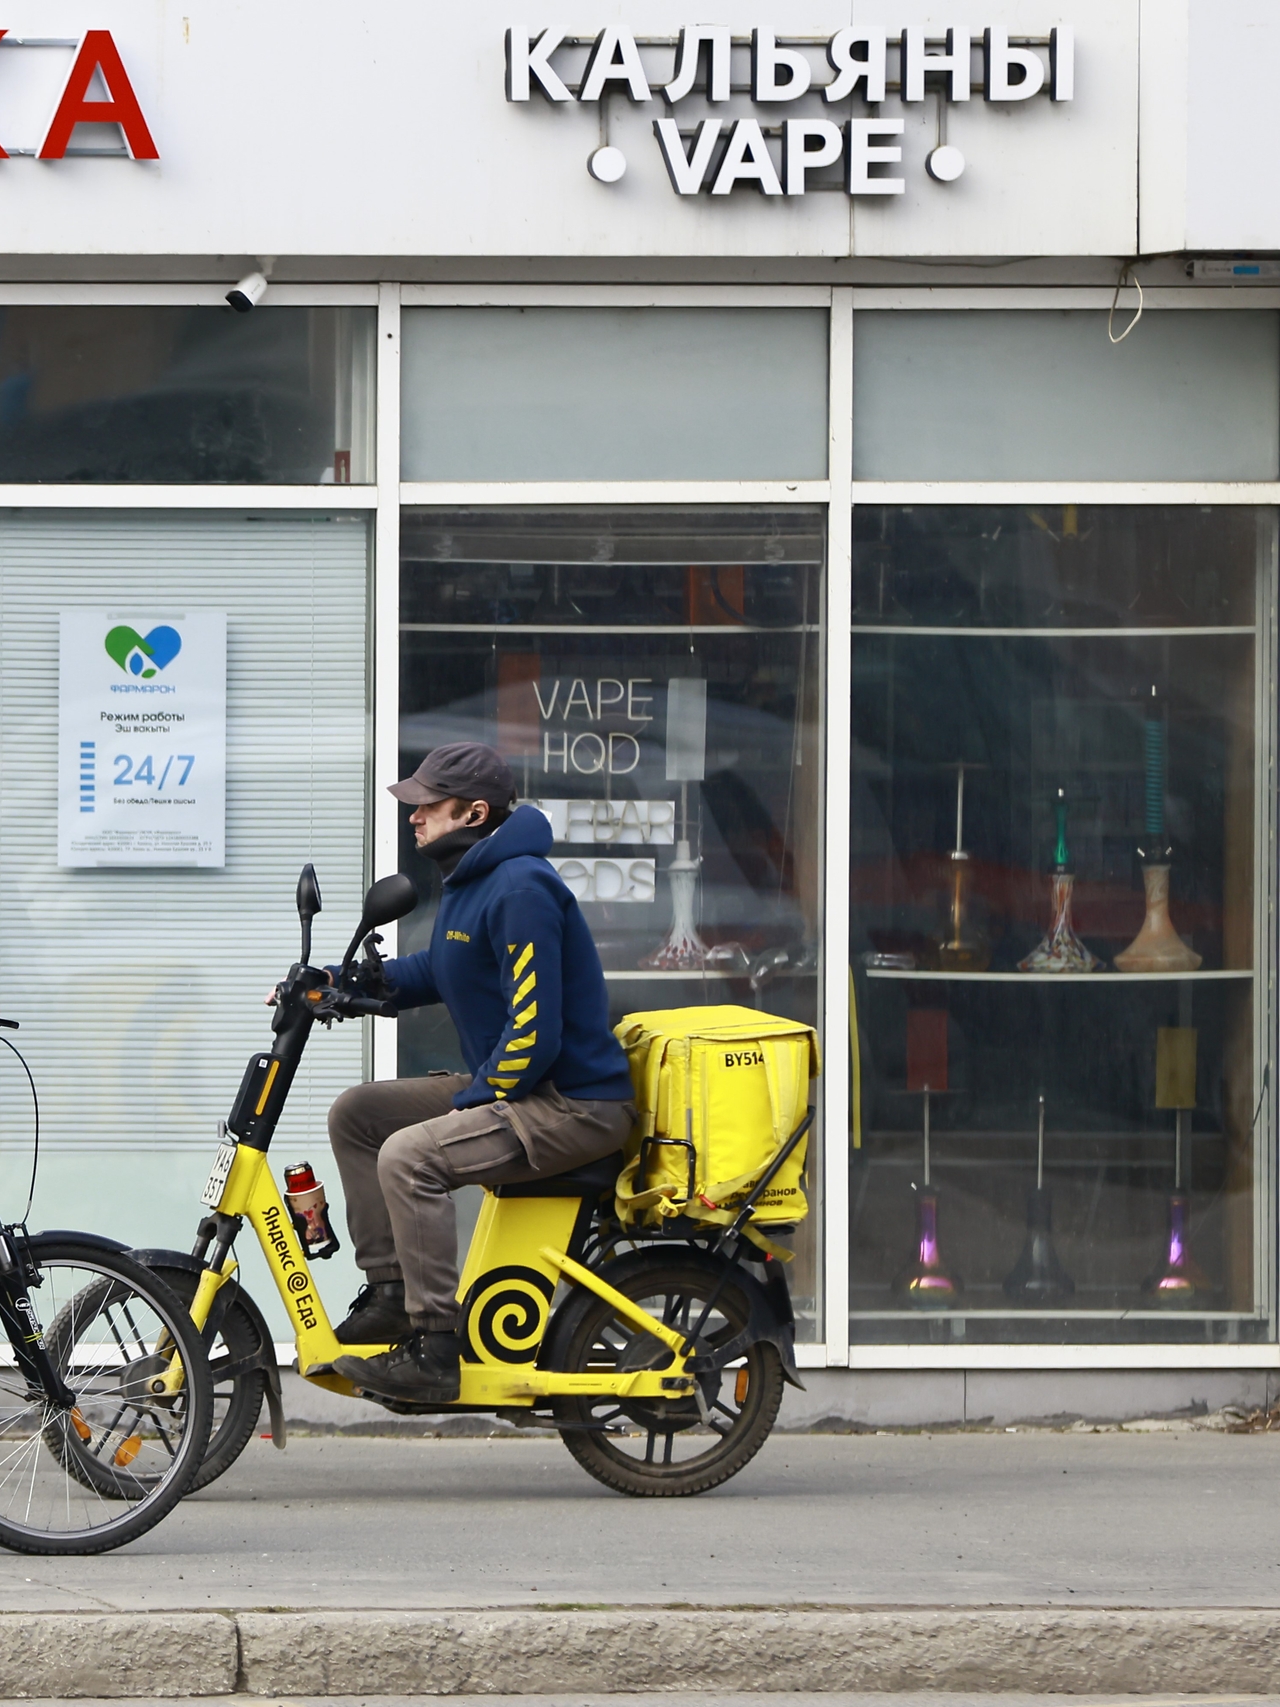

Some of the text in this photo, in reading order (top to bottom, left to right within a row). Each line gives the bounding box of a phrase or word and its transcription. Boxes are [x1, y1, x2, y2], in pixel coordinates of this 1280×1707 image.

[506, 24, 1075, 102] КАЛЬЯНЫ
[653, 118, 906, 195] VAPE
[110, 684, 176, 694] ФАРМАРОН
[532, 678, 654, 721] VAPE
[100, 711, 185, 723] Режим работы
[115, 723, 131, 733] Эш
[113, 754, 196, 791] 24/7
[543, 732, 640, 774] HQD
[558, 860, 656, 901] ODS
[261, 1206, 318, 1330] Яндекс Еда
